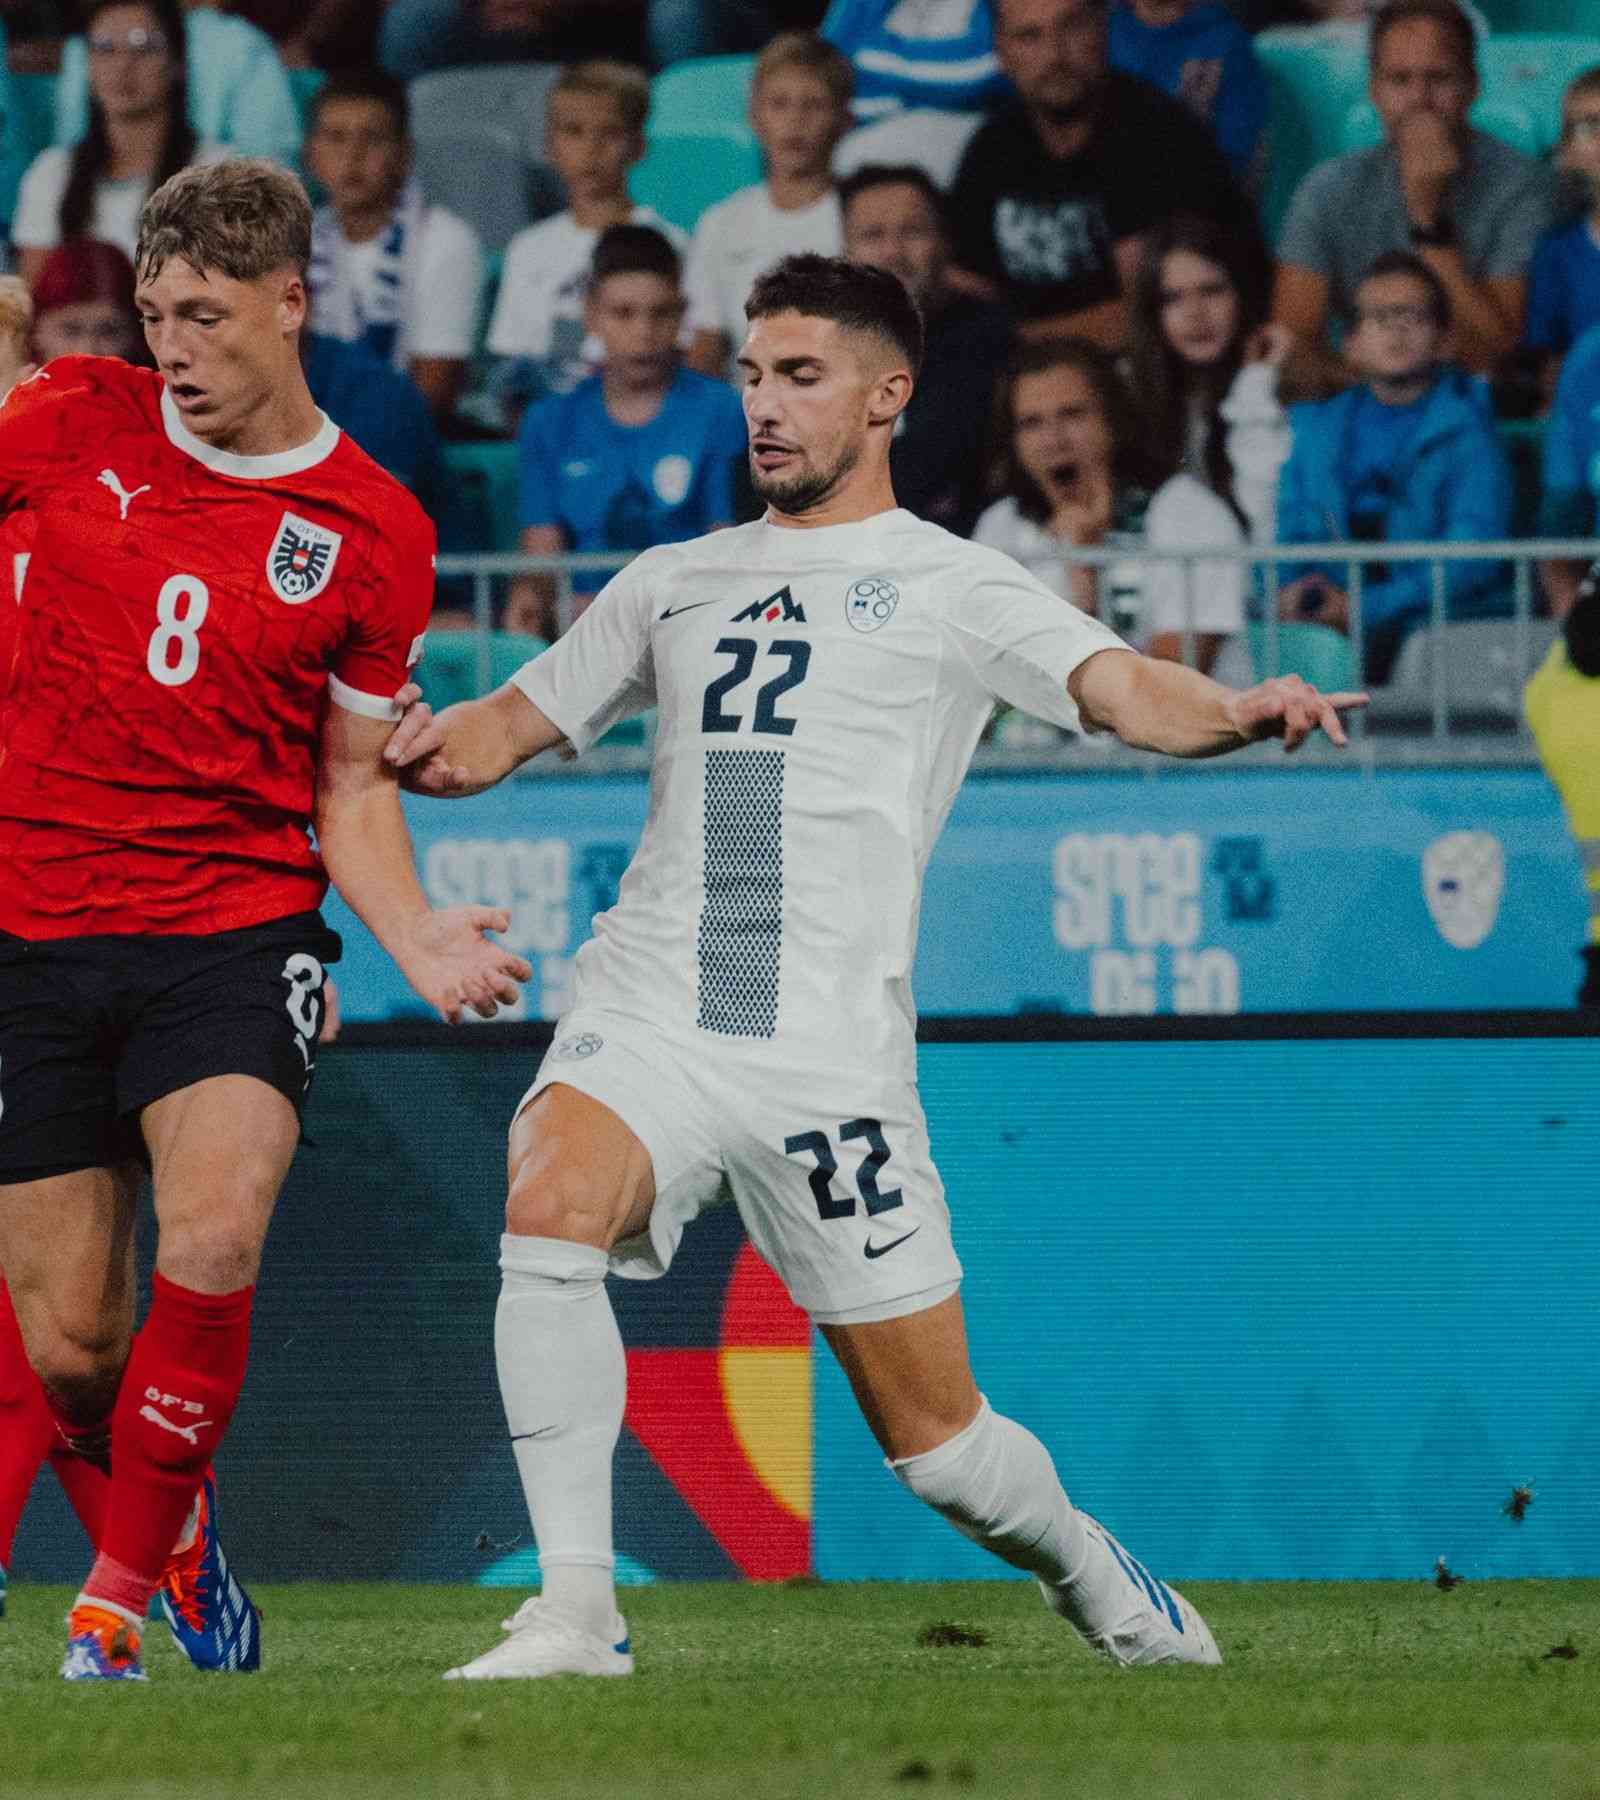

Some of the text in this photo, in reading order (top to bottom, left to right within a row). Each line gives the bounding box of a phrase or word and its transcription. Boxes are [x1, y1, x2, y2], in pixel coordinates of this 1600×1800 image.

[147, 573, 209, 687] 8
[702, 638, 812, 736] 22
[784, 1117, 904, 1221] 22
[144, 1386, 204, 1415] ÖFB
